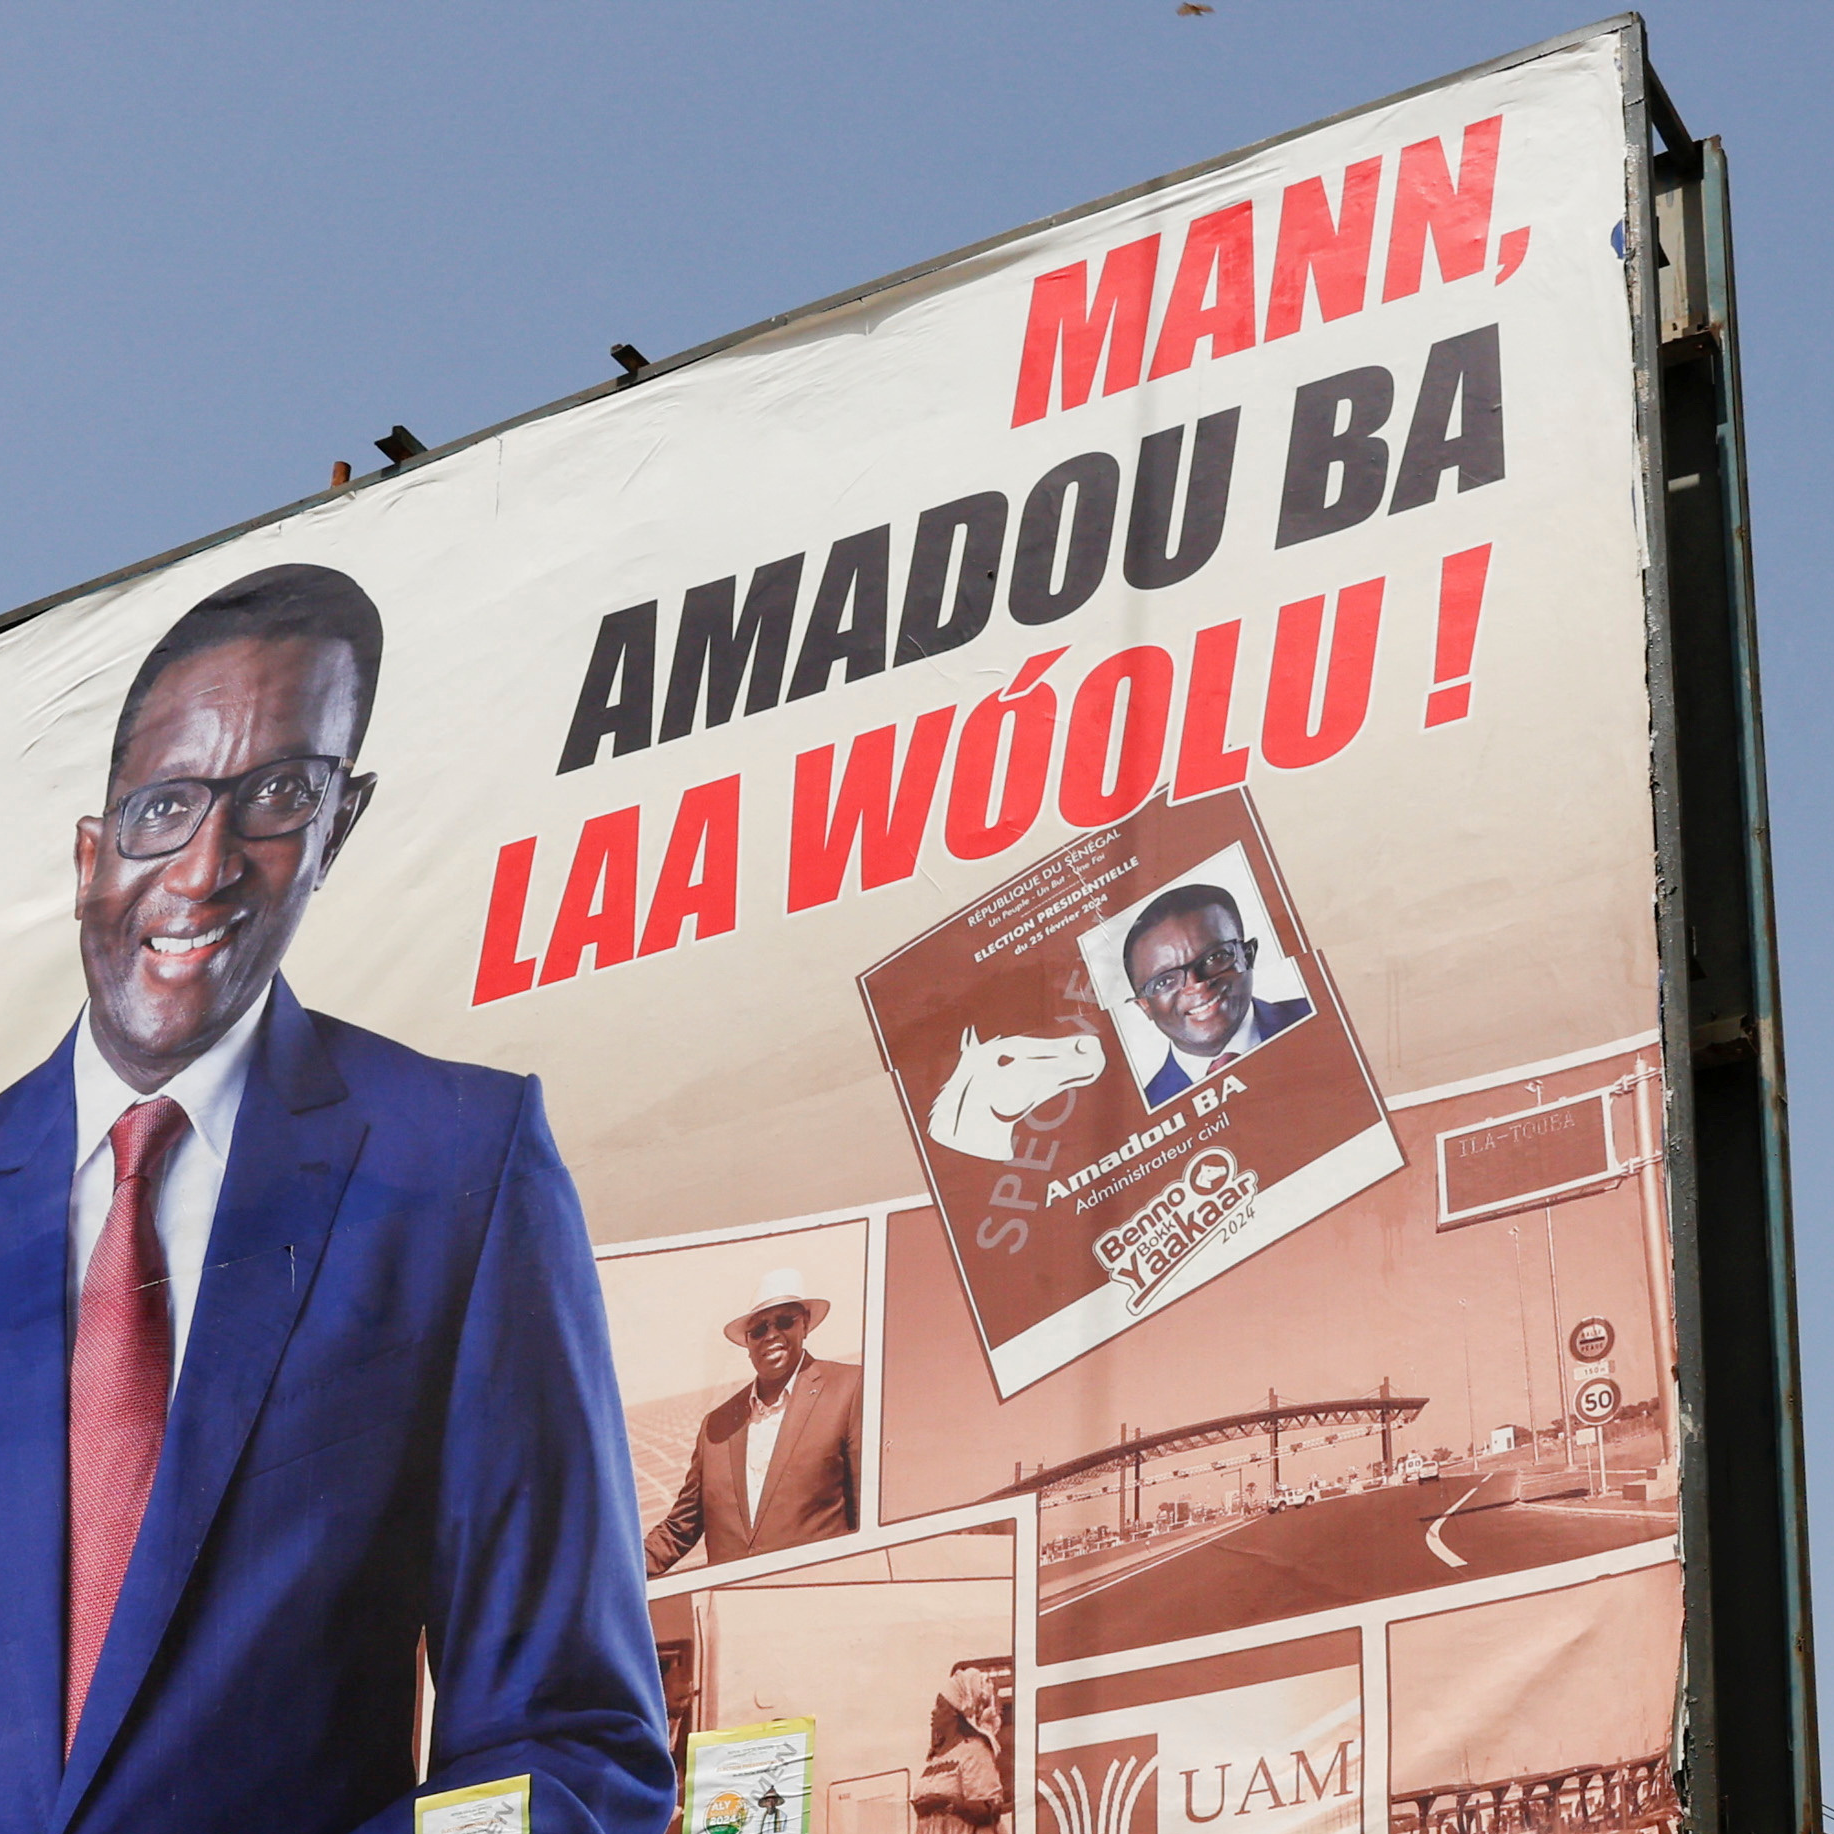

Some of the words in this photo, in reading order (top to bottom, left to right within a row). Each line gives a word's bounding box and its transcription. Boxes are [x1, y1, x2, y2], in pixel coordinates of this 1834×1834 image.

[1011, 115, 1530, 430] MANN,
[557, 406, 1241, 776] AMADOU
[1274, 322, 1506, 550] BA
[471, 774, 741, 1007] LAA
[786, 576, 1385, 915] WÓOLU
[1424, 542, 1493, 729] !
[967, 875, 1040, 927] RÉPUBLIQUE
[1042, 862, 1062, 880] DU
[1065, 829, 1121, 866] SÉNÉGAL
[973, 918, 1035, 963] ELECTION
[1036, 856, 1139, 923] PRESIDENTIELLE
[988, 917, 1001, 928] Un
[1002, 898, 1030, 922] Peuple
[1036, 885, 1049, 897] Un
[1051, 876, 1065, 889] But
[1091, 853, 1105, 865] Foi
[1014, 943, 1028, 955] du
[1029, 933, 1043, 946] 25
[1045, 911, 1080, 936] février
[1081, 893, 1109, 914] 2024
[1045, 1112, 1186, 1208] Amadou
[1192, 1074, 1248, 1118] BA
[1075, 1136, 1193, 1215] Administrateur
[1197, 1112, 1230, 1141] civil
[1099, 1186, 1186, 1263] Benno
[1117, 1175, 1256, 1290] Yaakaar
[1219, 1206, 1257, 1244] 2024
[1585, 1390, 1612, 1412] 50
[711, 1801, 731, 1811] ALY
[1177, 1740, 1356, 1826] UAM
